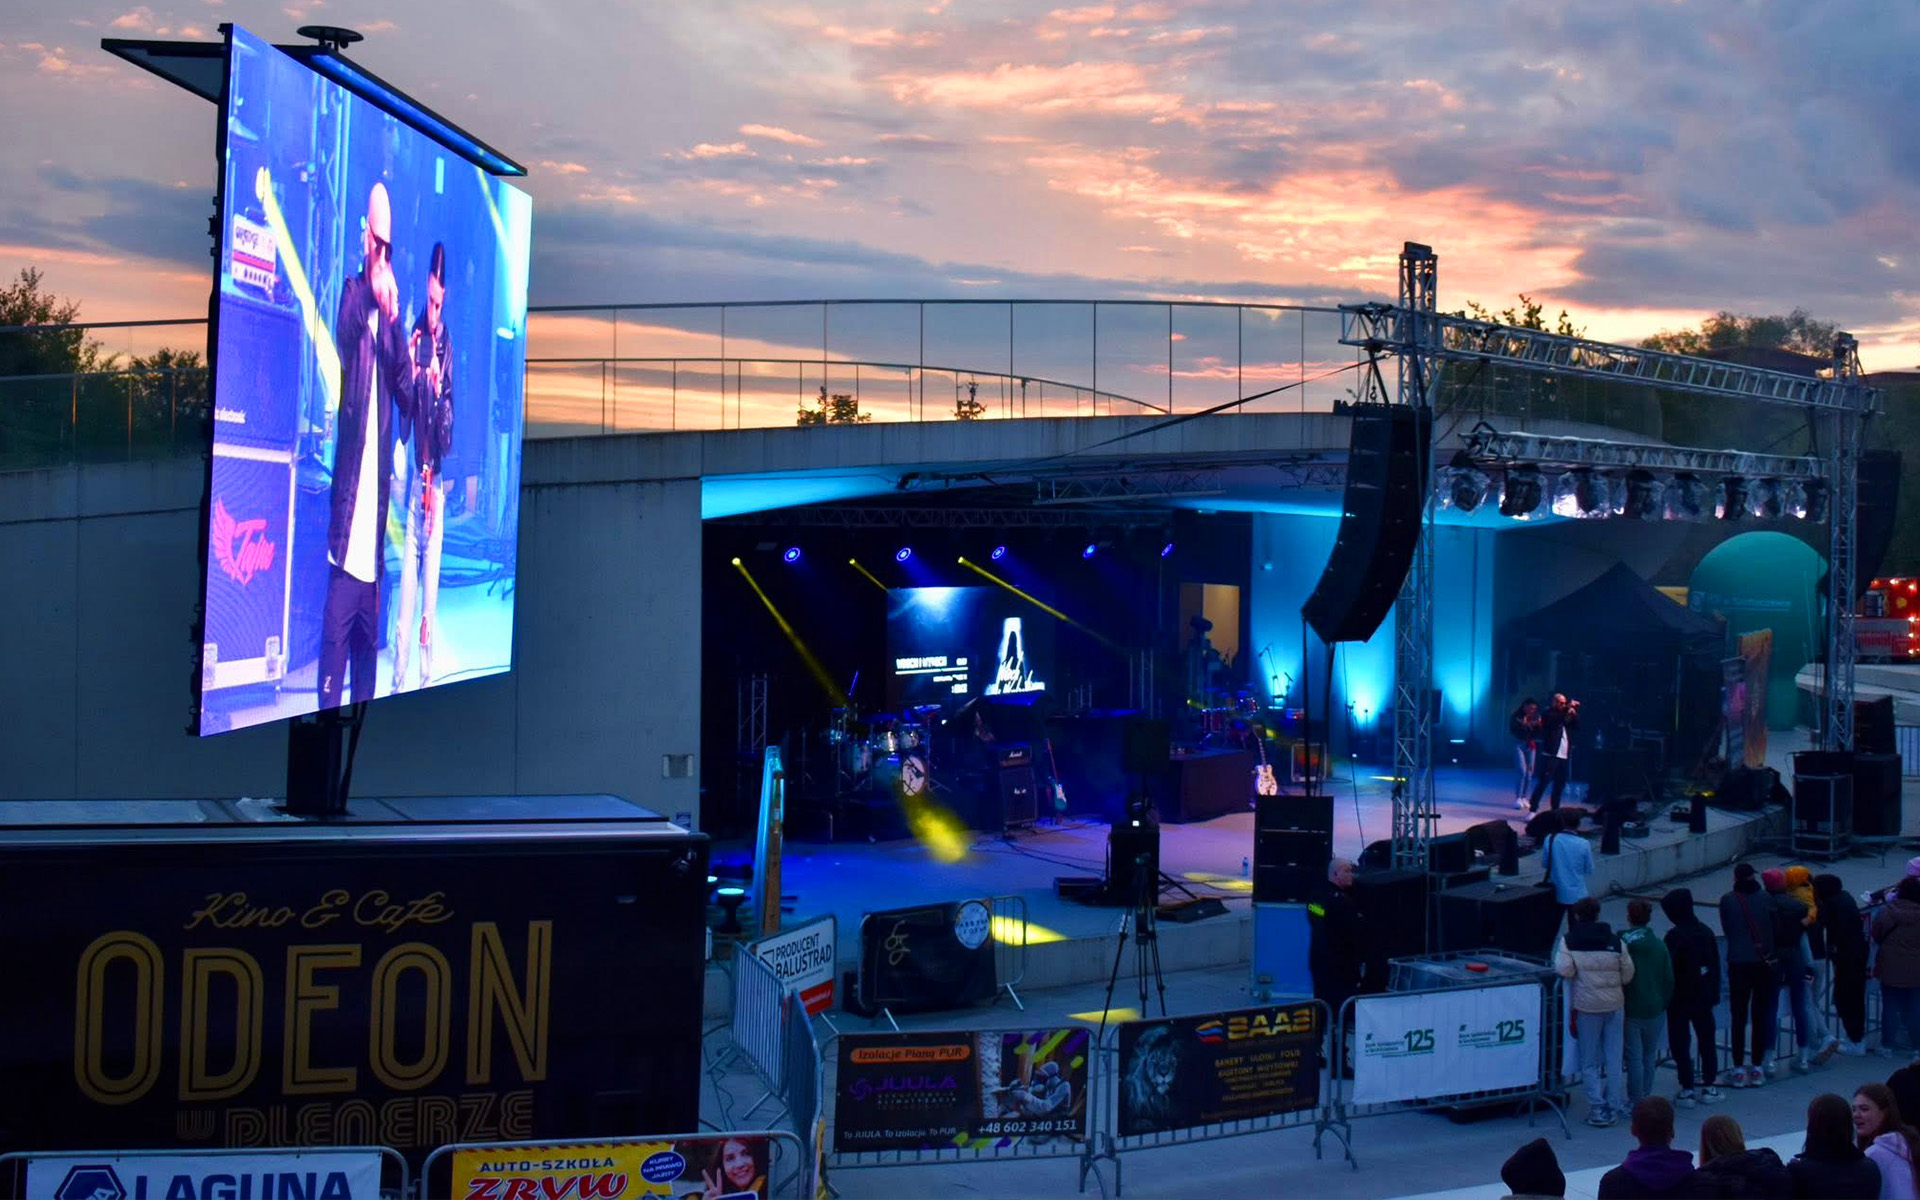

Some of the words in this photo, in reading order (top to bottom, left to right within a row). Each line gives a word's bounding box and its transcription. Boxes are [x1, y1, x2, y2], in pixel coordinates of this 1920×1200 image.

[183, 891, 295, 928] Kino
[775, 933, 820, 961] PRODUCENT
[775, 944, 832, 979] BALUSTRAD
[74, 920, 553, 1105] ODEON
[1404, 1029, 1435, 1052] 125
[1495, 1019, 1525, 1043] 125
[938, 1047, 963, 1058] PUR
[979, 1122, 1001, 1134] +48
[1003, 1121, 1026, 1133] 602
[1029, 1121, 1052, 1132] 340
[1055, 1119, 1077, 1131] 151
[480, 1157, 615, 1172] AUTO-SZKOŁA
[133, 1171, 353, 1200] LAGUNA
[465, 1172, 629, 1200] ZRYW
